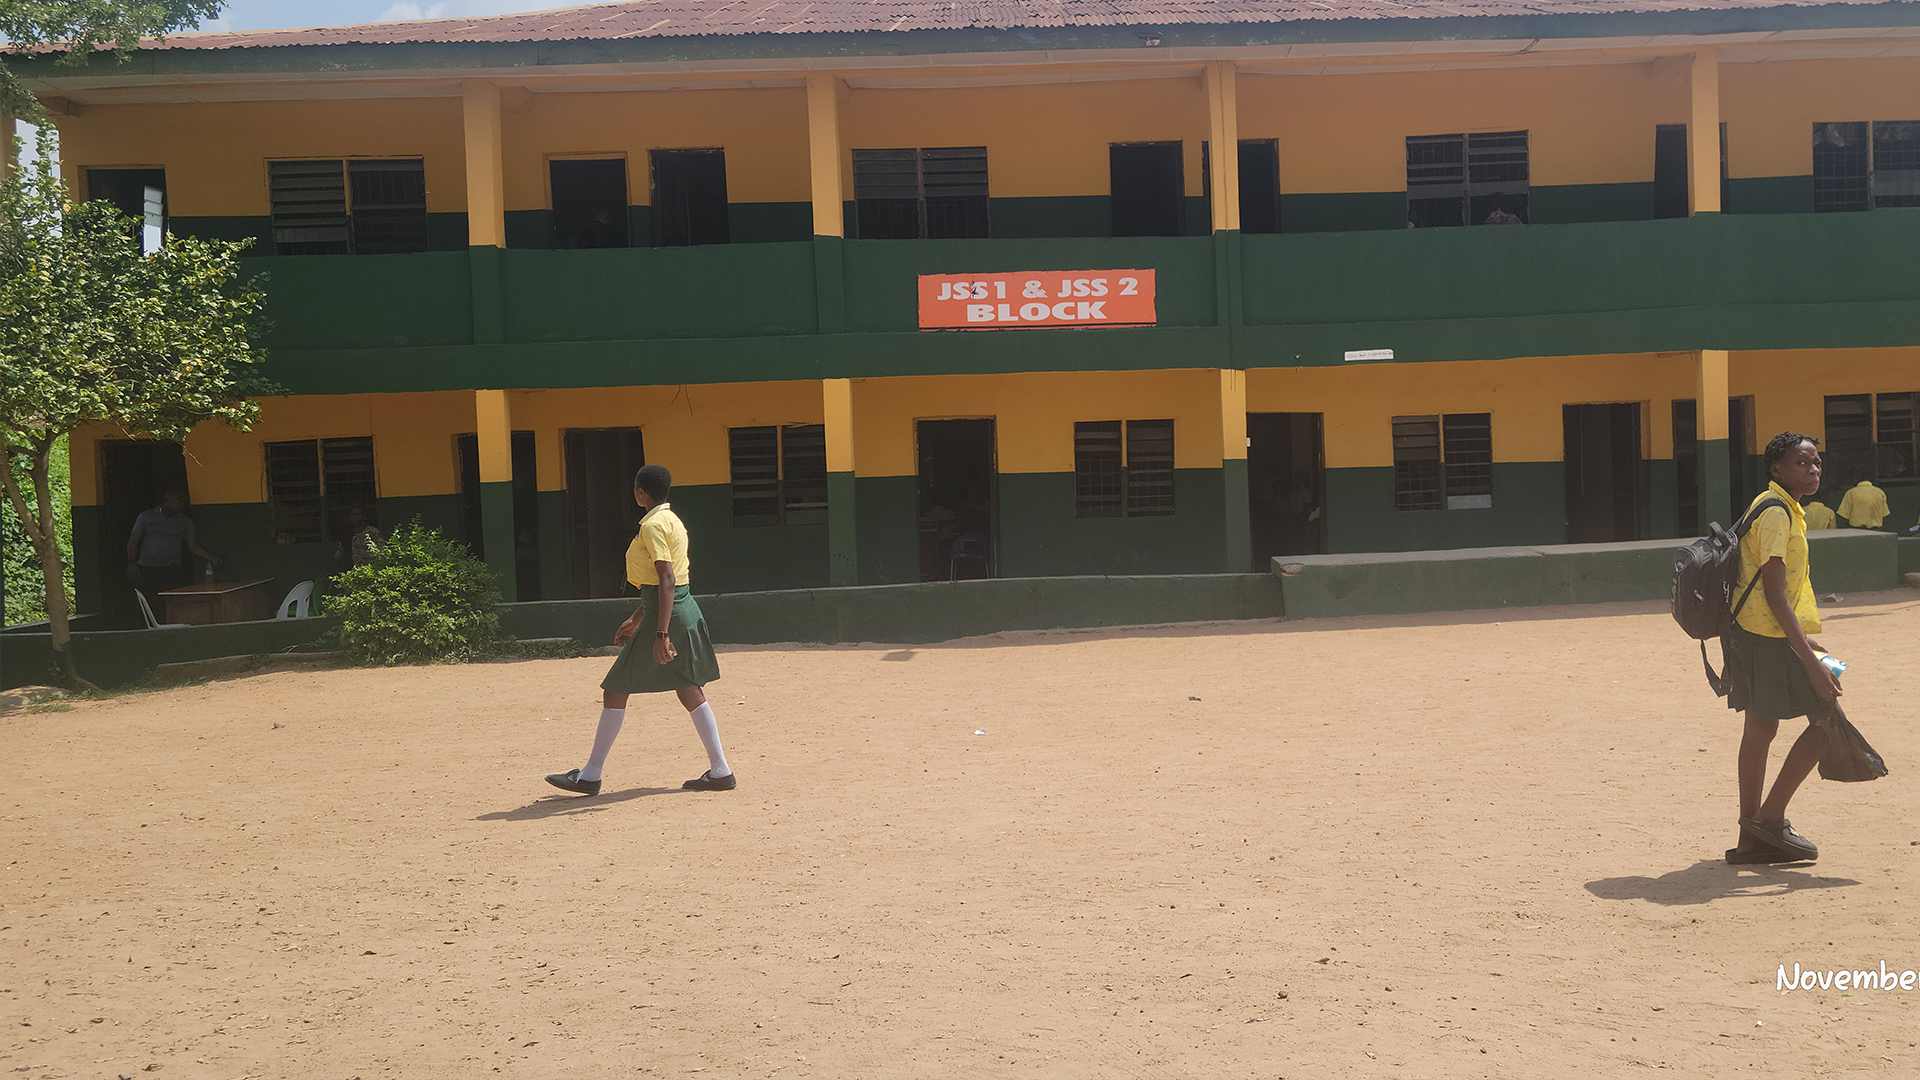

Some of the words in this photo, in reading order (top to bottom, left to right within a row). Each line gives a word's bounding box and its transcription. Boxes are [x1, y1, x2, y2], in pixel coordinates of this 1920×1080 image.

[1022, 279, 1048, 298] &
[1057, 278, 1108, 298] JSS
[1119, 277, 1138, 296] 2
[966, 301, 1107, 322] BLOCK
